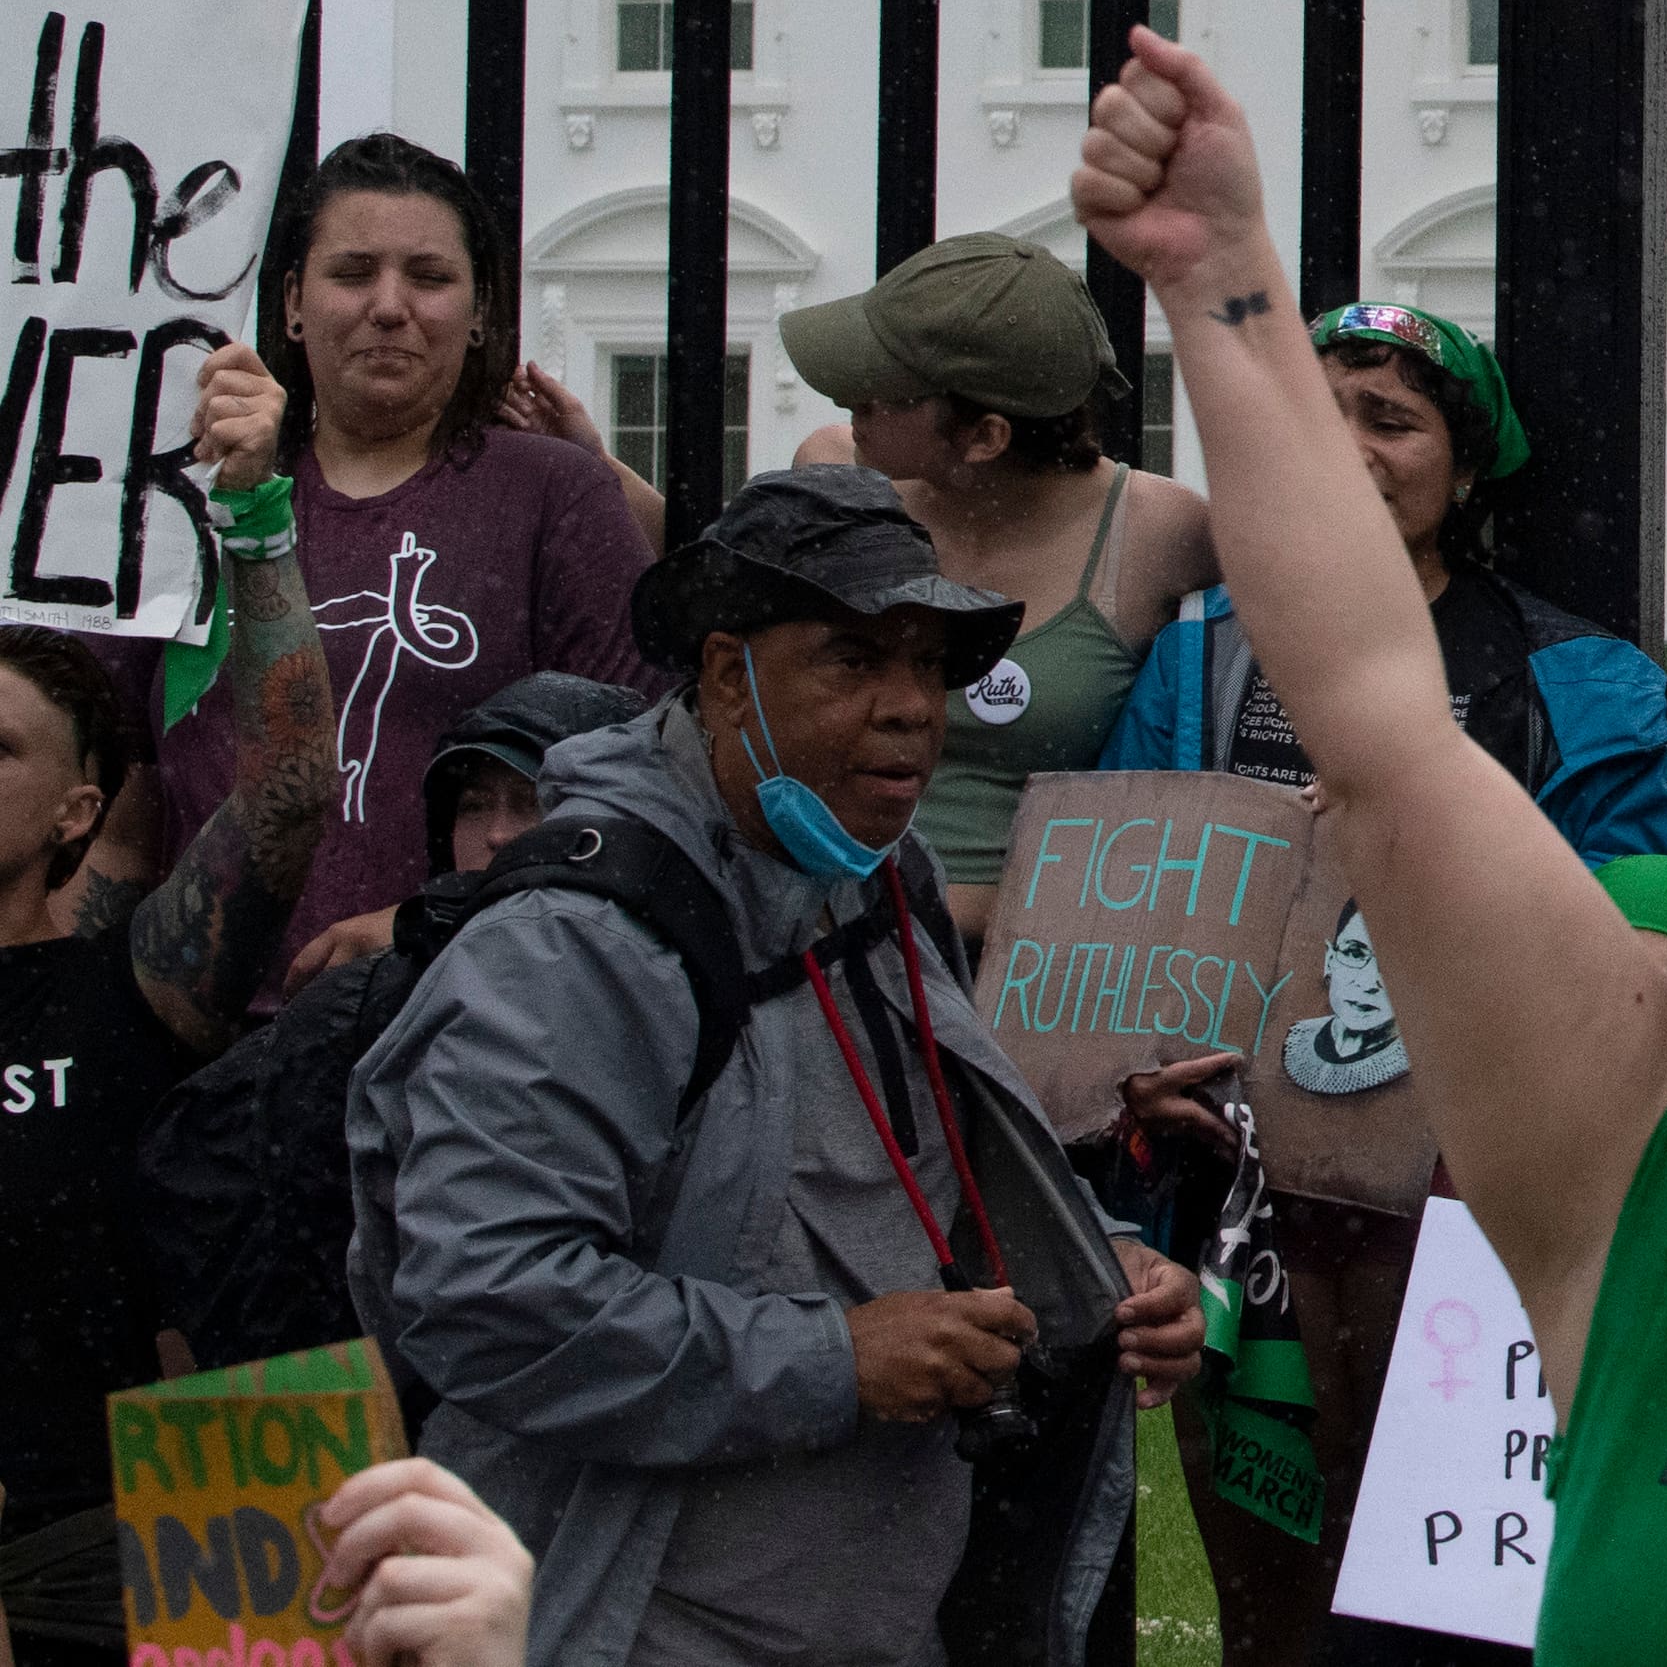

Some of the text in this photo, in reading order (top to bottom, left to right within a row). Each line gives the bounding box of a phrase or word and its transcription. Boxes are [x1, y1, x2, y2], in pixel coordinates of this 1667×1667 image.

[81, 614, 112, 630] 1988
[969, 674, 1024, 700] Ruth
[1270, 768, 1297, 781] ARE
[1024, 818, 1291, 926] FIGHT
[993, 939, 1294, 1056] RUTHLESSLY
